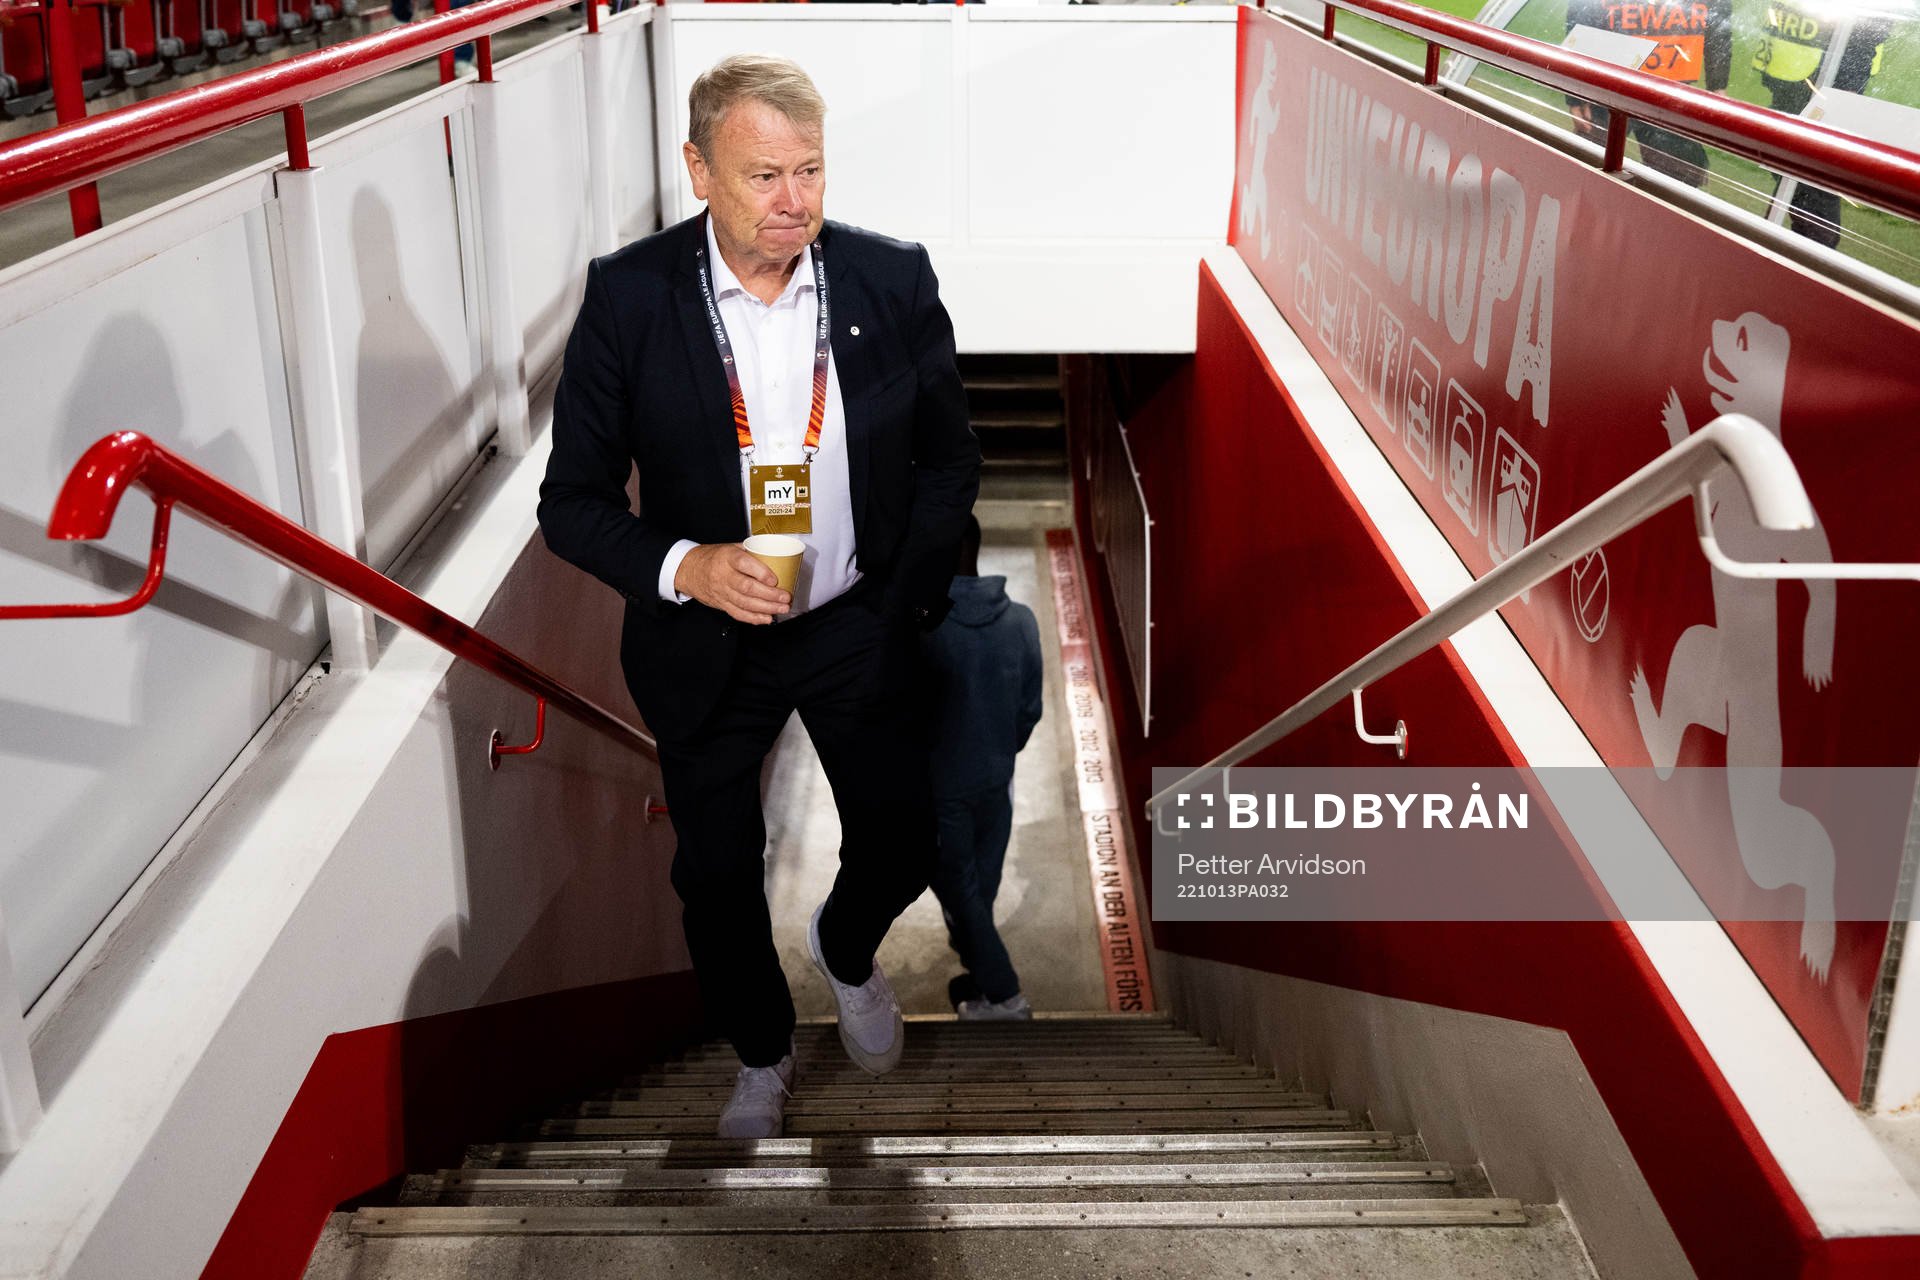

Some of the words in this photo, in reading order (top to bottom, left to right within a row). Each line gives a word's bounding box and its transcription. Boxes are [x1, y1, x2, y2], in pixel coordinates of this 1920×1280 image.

[1601, 2, 1709, 30] TEWAR
[699, 268, 709, 296] LEAGUE
[818, 261, 826, 289] LEAGUE
[706, 296, 720, 324] EUROPA
[820, 290, 828, 318] EUROPA
[714, 324, 726, 344] UEFA
[819, 319, 828, 339] UEFA
[1092, 815, 1117, 866] STADION
[1100, 870, 1123, 888] AN
[1103, 890, 1126, 918] DER
[1107, 921, 1136, 967] ALTEN
